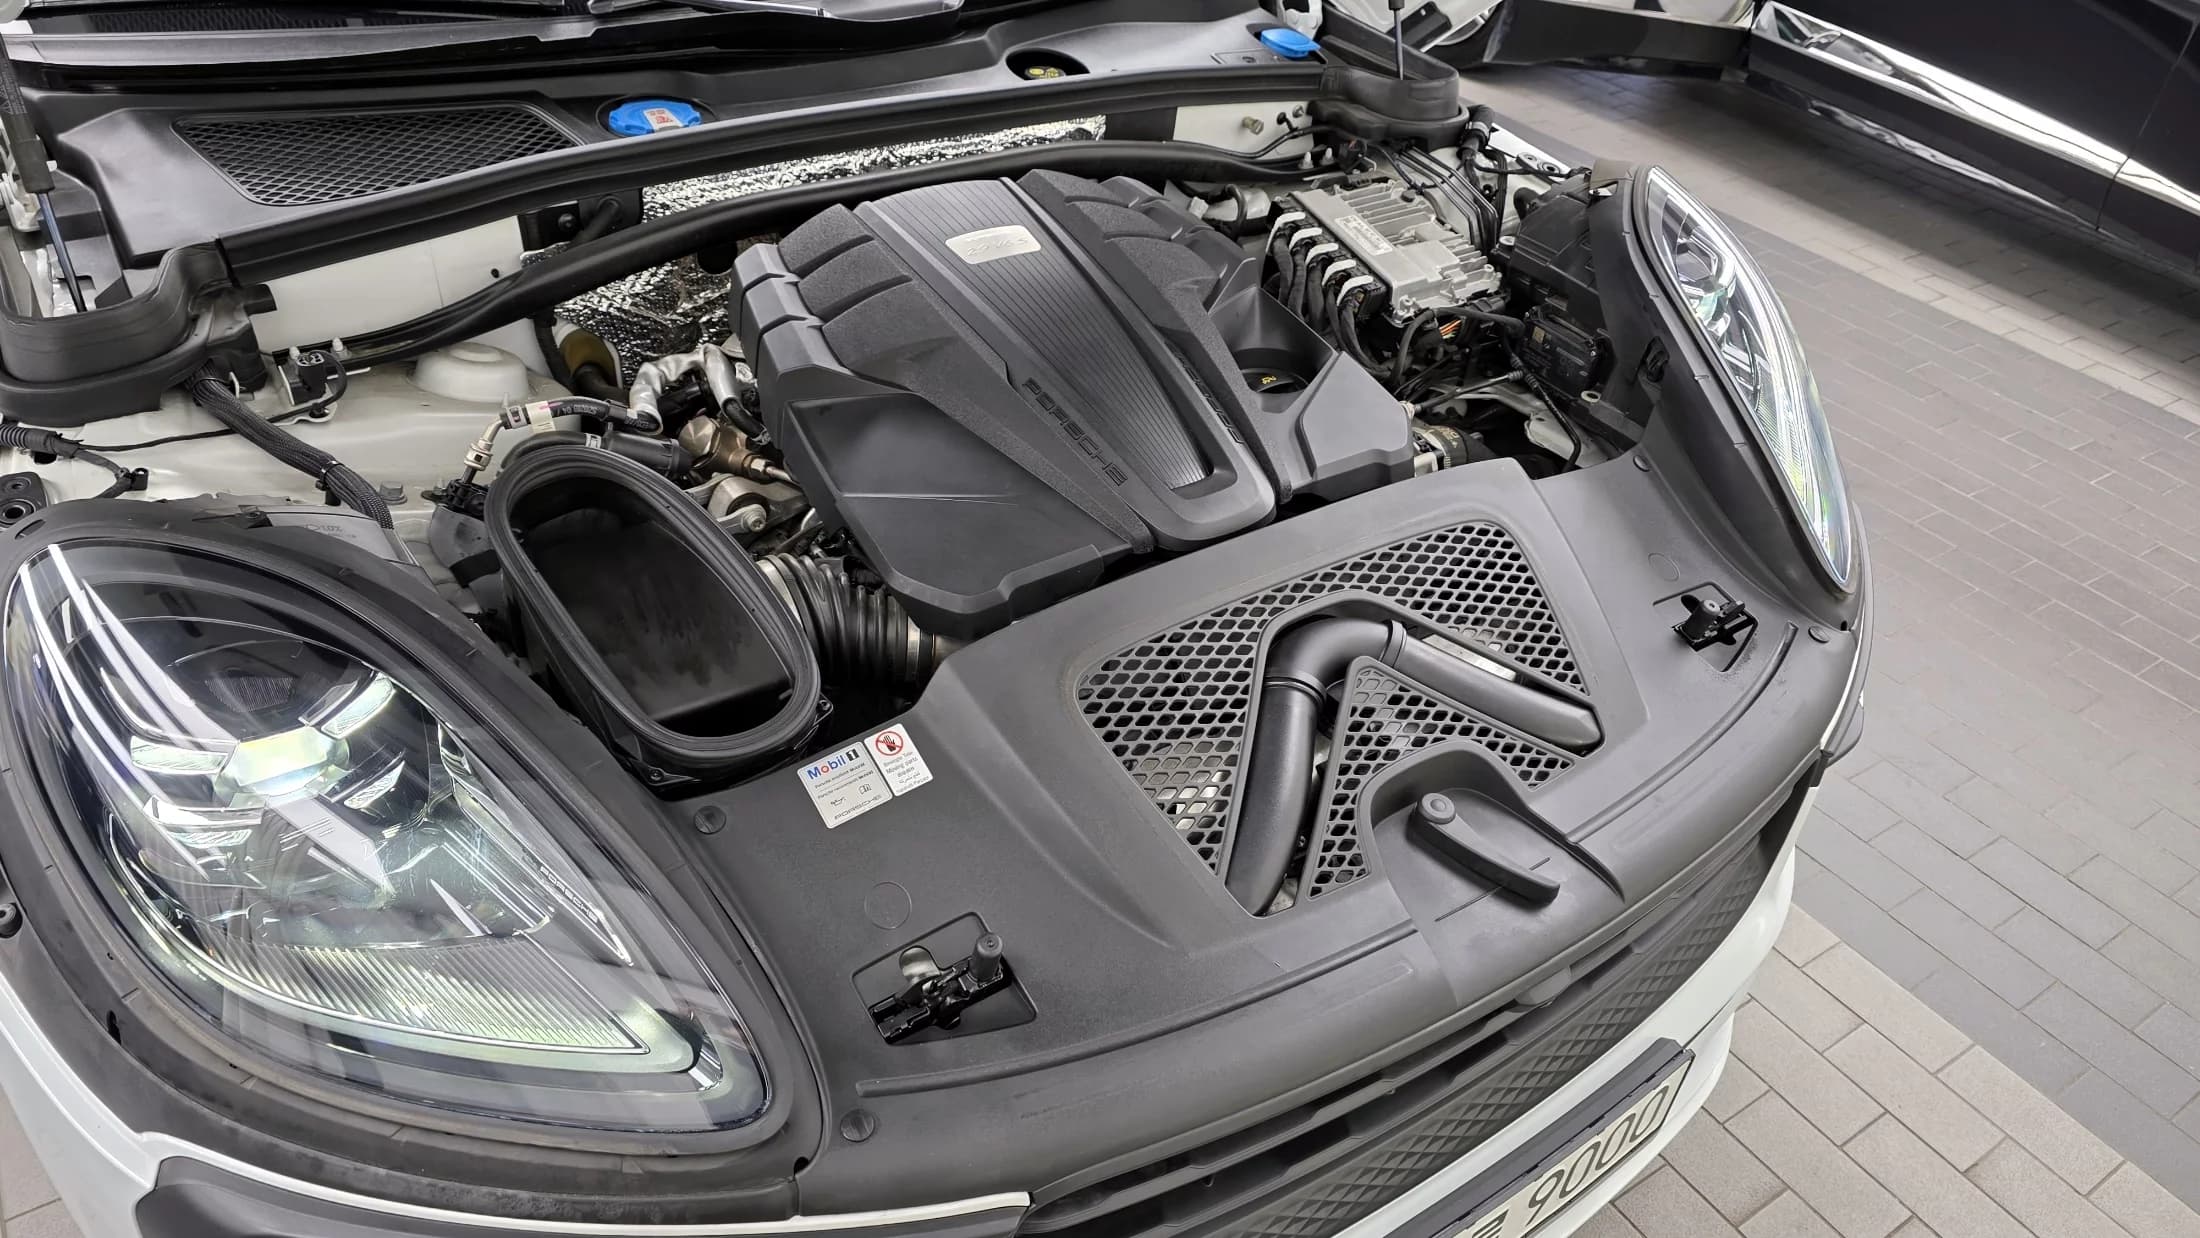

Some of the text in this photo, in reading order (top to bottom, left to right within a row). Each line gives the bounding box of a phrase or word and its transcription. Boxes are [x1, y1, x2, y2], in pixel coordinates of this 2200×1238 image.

[1022, 378, 1128, 486] PORSCHE
[806, 755, 846, 780] Mobil
[846, 749, 860, 762] 1
[1525, 1084, 1669, 1227] 9000
